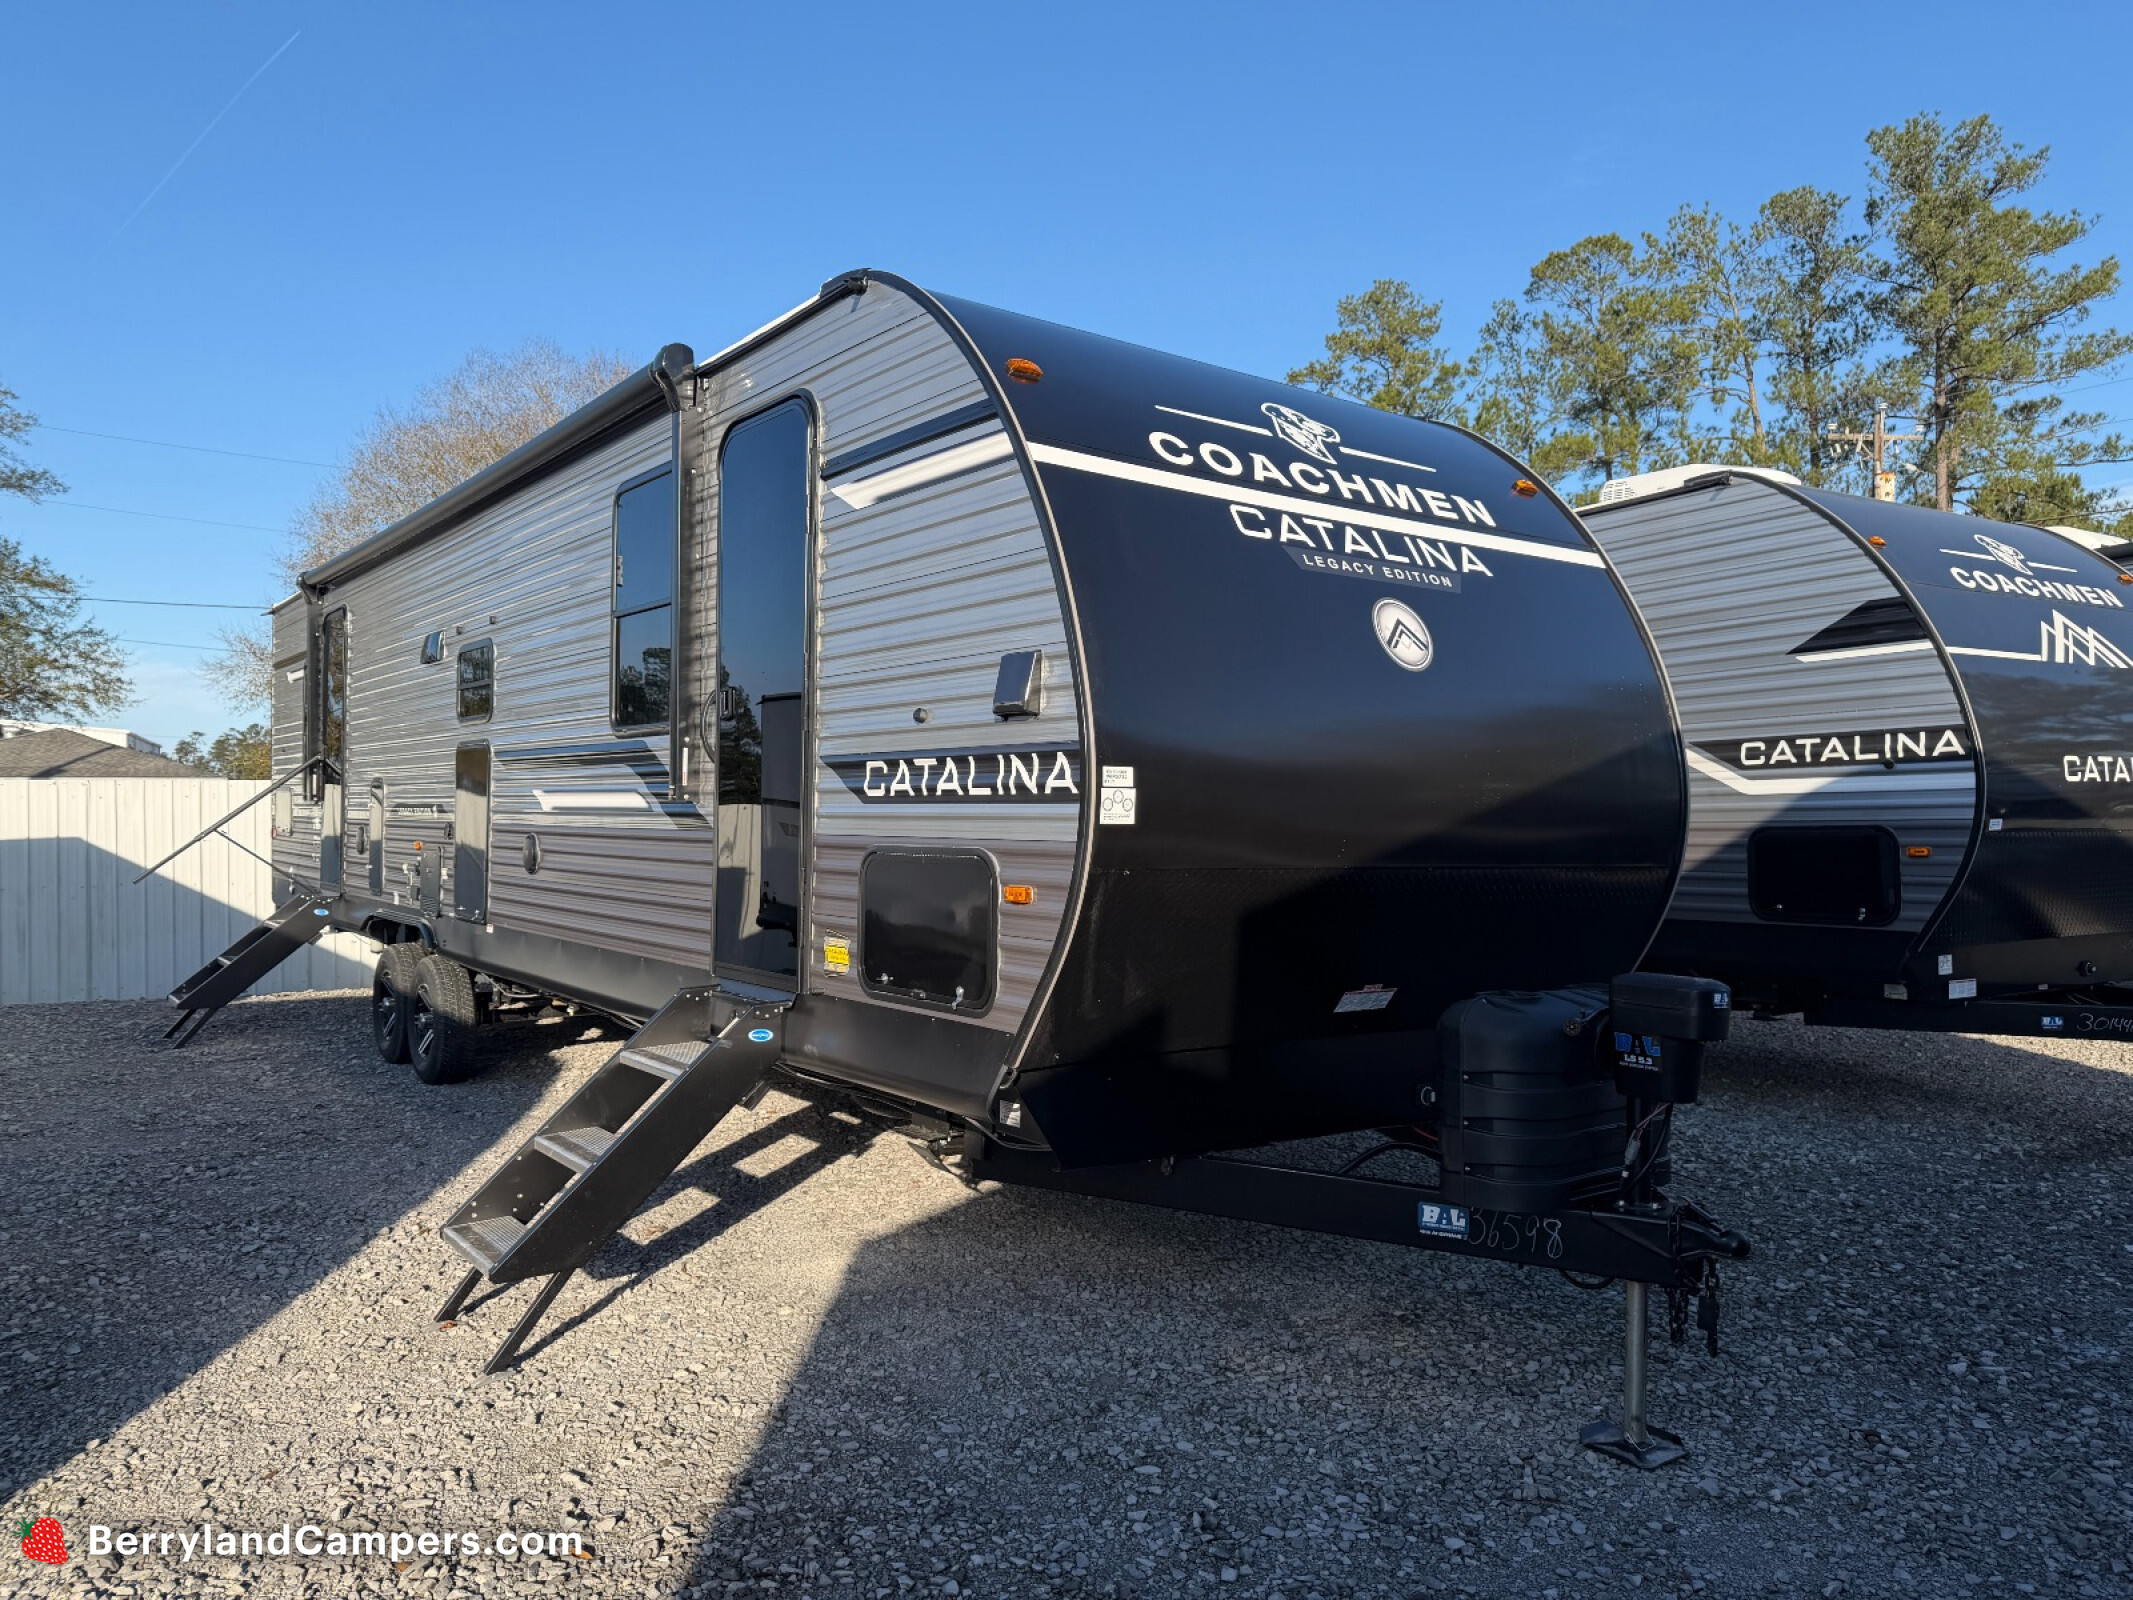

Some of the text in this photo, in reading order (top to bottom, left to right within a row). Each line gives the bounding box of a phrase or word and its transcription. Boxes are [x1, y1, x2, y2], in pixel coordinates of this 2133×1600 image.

[1148, 431, 1497, 528] COACHMEN
[1229, 503, 1494, 577] CATALINA
[1301, 553, 1453, 588] LEGACY EDITION
[1949, 566, 2125, 608] COACHMEN
[1740, 729, 1966, 766] CATALINA
[863, 751, 1079, 797] CATALINA
[2063, 755, 2133, 783] CATA
[1421, 1204, 1466, 1228] BAL
[1468, 1206, 1563, 1258] 36598
